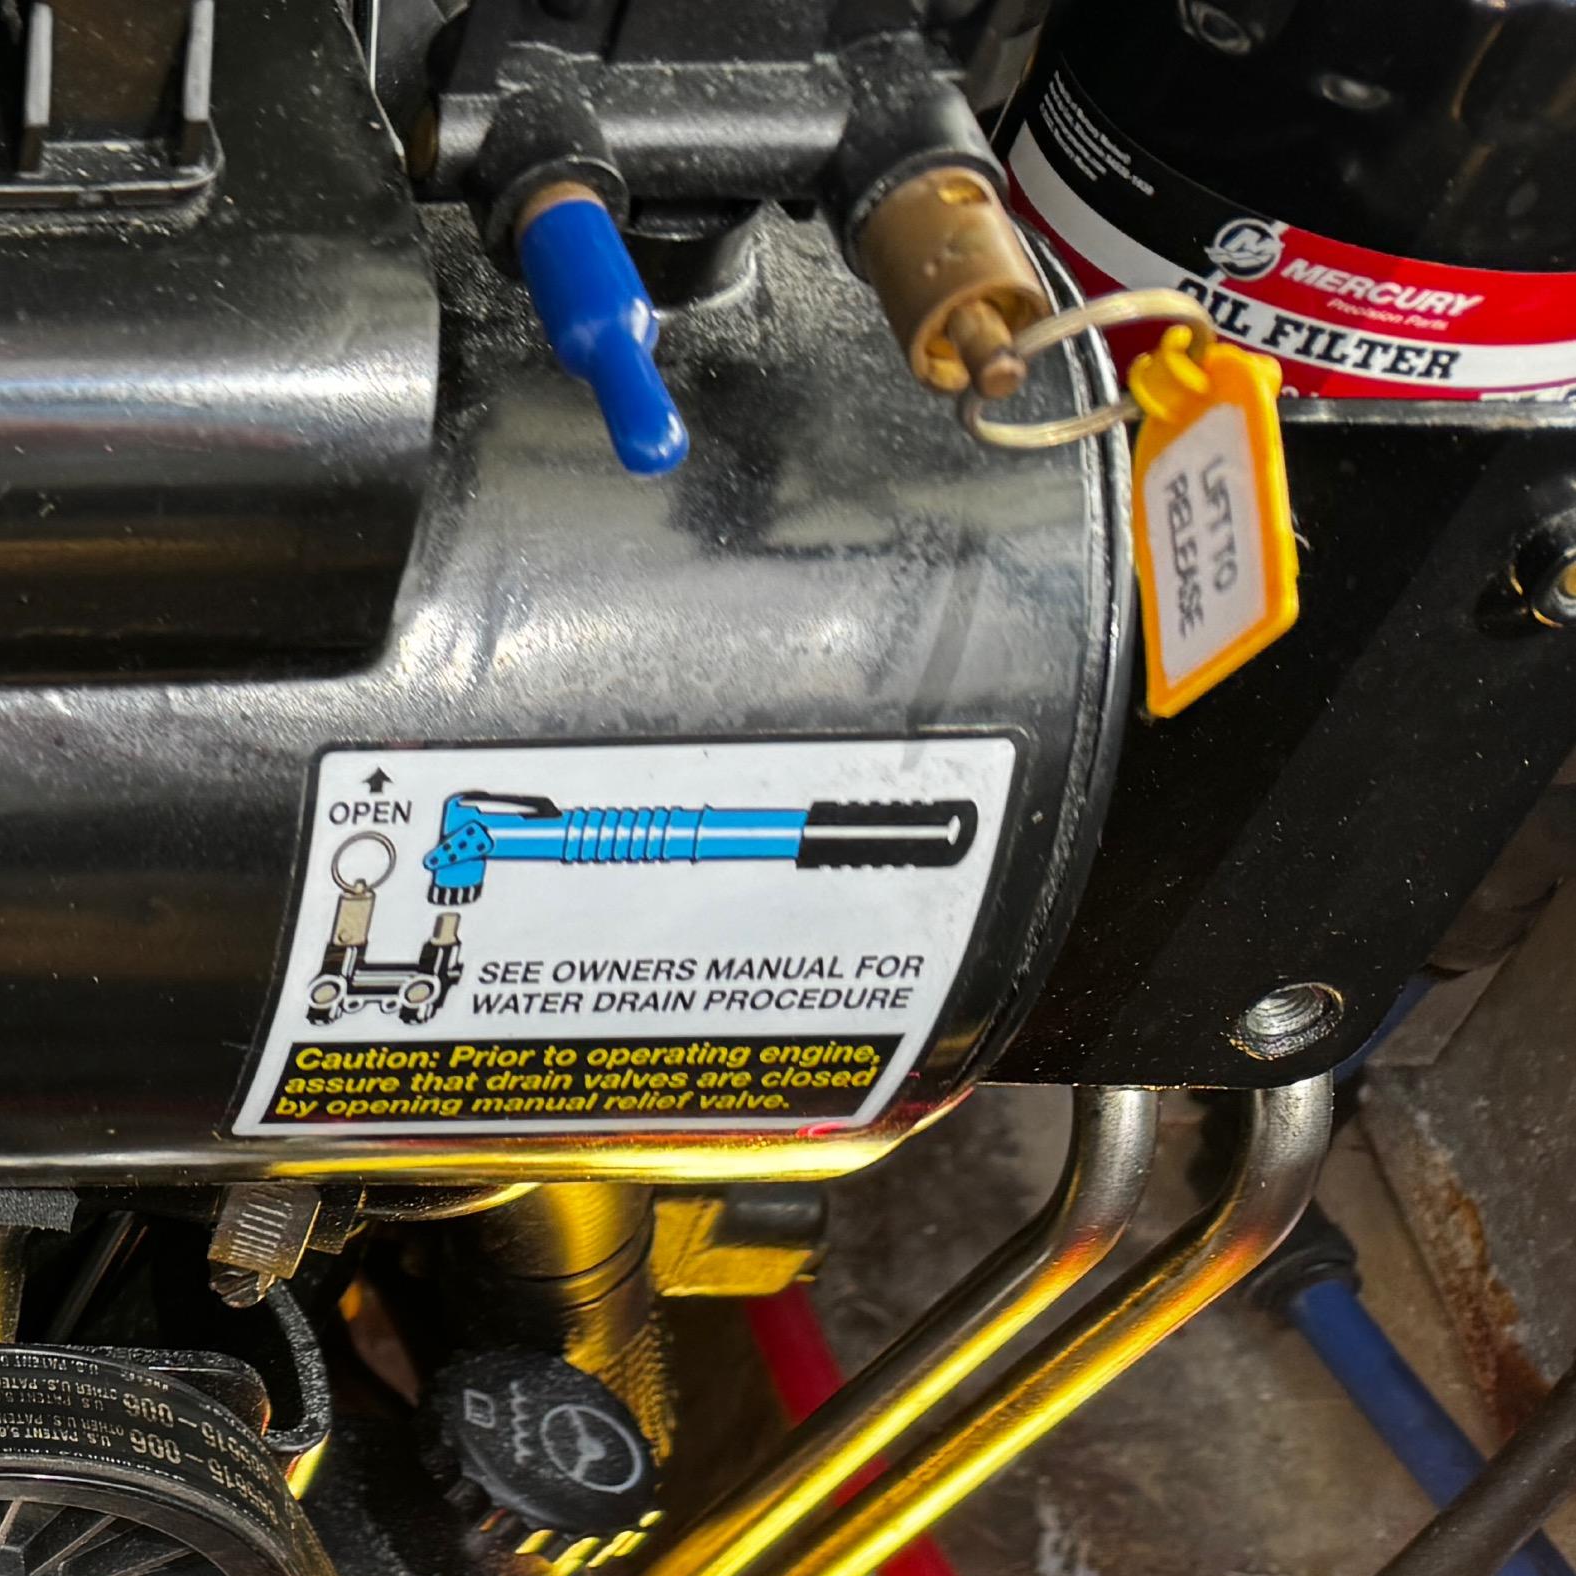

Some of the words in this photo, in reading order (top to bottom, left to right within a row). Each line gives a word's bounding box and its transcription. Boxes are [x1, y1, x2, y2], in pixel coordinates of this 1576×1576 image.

[1280, 258, 1485, 317] MERCURY
[1261, 314, 1461, 380] FILTER
[328, 800, 413, 827] OPEN
[477, 960, 544, 985] SEE
[552, 958, 697, 984] OWNERS
[705, 956, 844, 981] MANUAL
[855, 955, 925, 979] FOR
[472, 991, 584, 1015] WATER
[593, 990, 696, 1014] DRAIN
[703, 987, 914, 1012] PROCEDURE
[295, 1047, 441, 1070] Caution:
[449, 1045, 536, 1069] Prior
[543, 1045, 578, 1068] to
[587, 1042, 751, 1070] operating
[759, 1041, 881, 1068] engine,
[284, 1076, 401, 1095] assure
[410, 1072, 479, 1094] that
[486, 1070, 573, 1092] drain
[584, 1068, 689, 1090] valves
[697, 1071, 752, 1089] are
[761, 1066, 878, 1088] closed
[275, 1096, 317, 1118] by
[325, 1094, 462, 1117] opening
[470, 1092, 598, 1113] manual
[603, 1090, 695, 1112] relief
[699, 1092, 790, 1111] valve.
[25, 1428, 78, 1442] PATENT
[82, 1419, 125, 1436] OTHER
